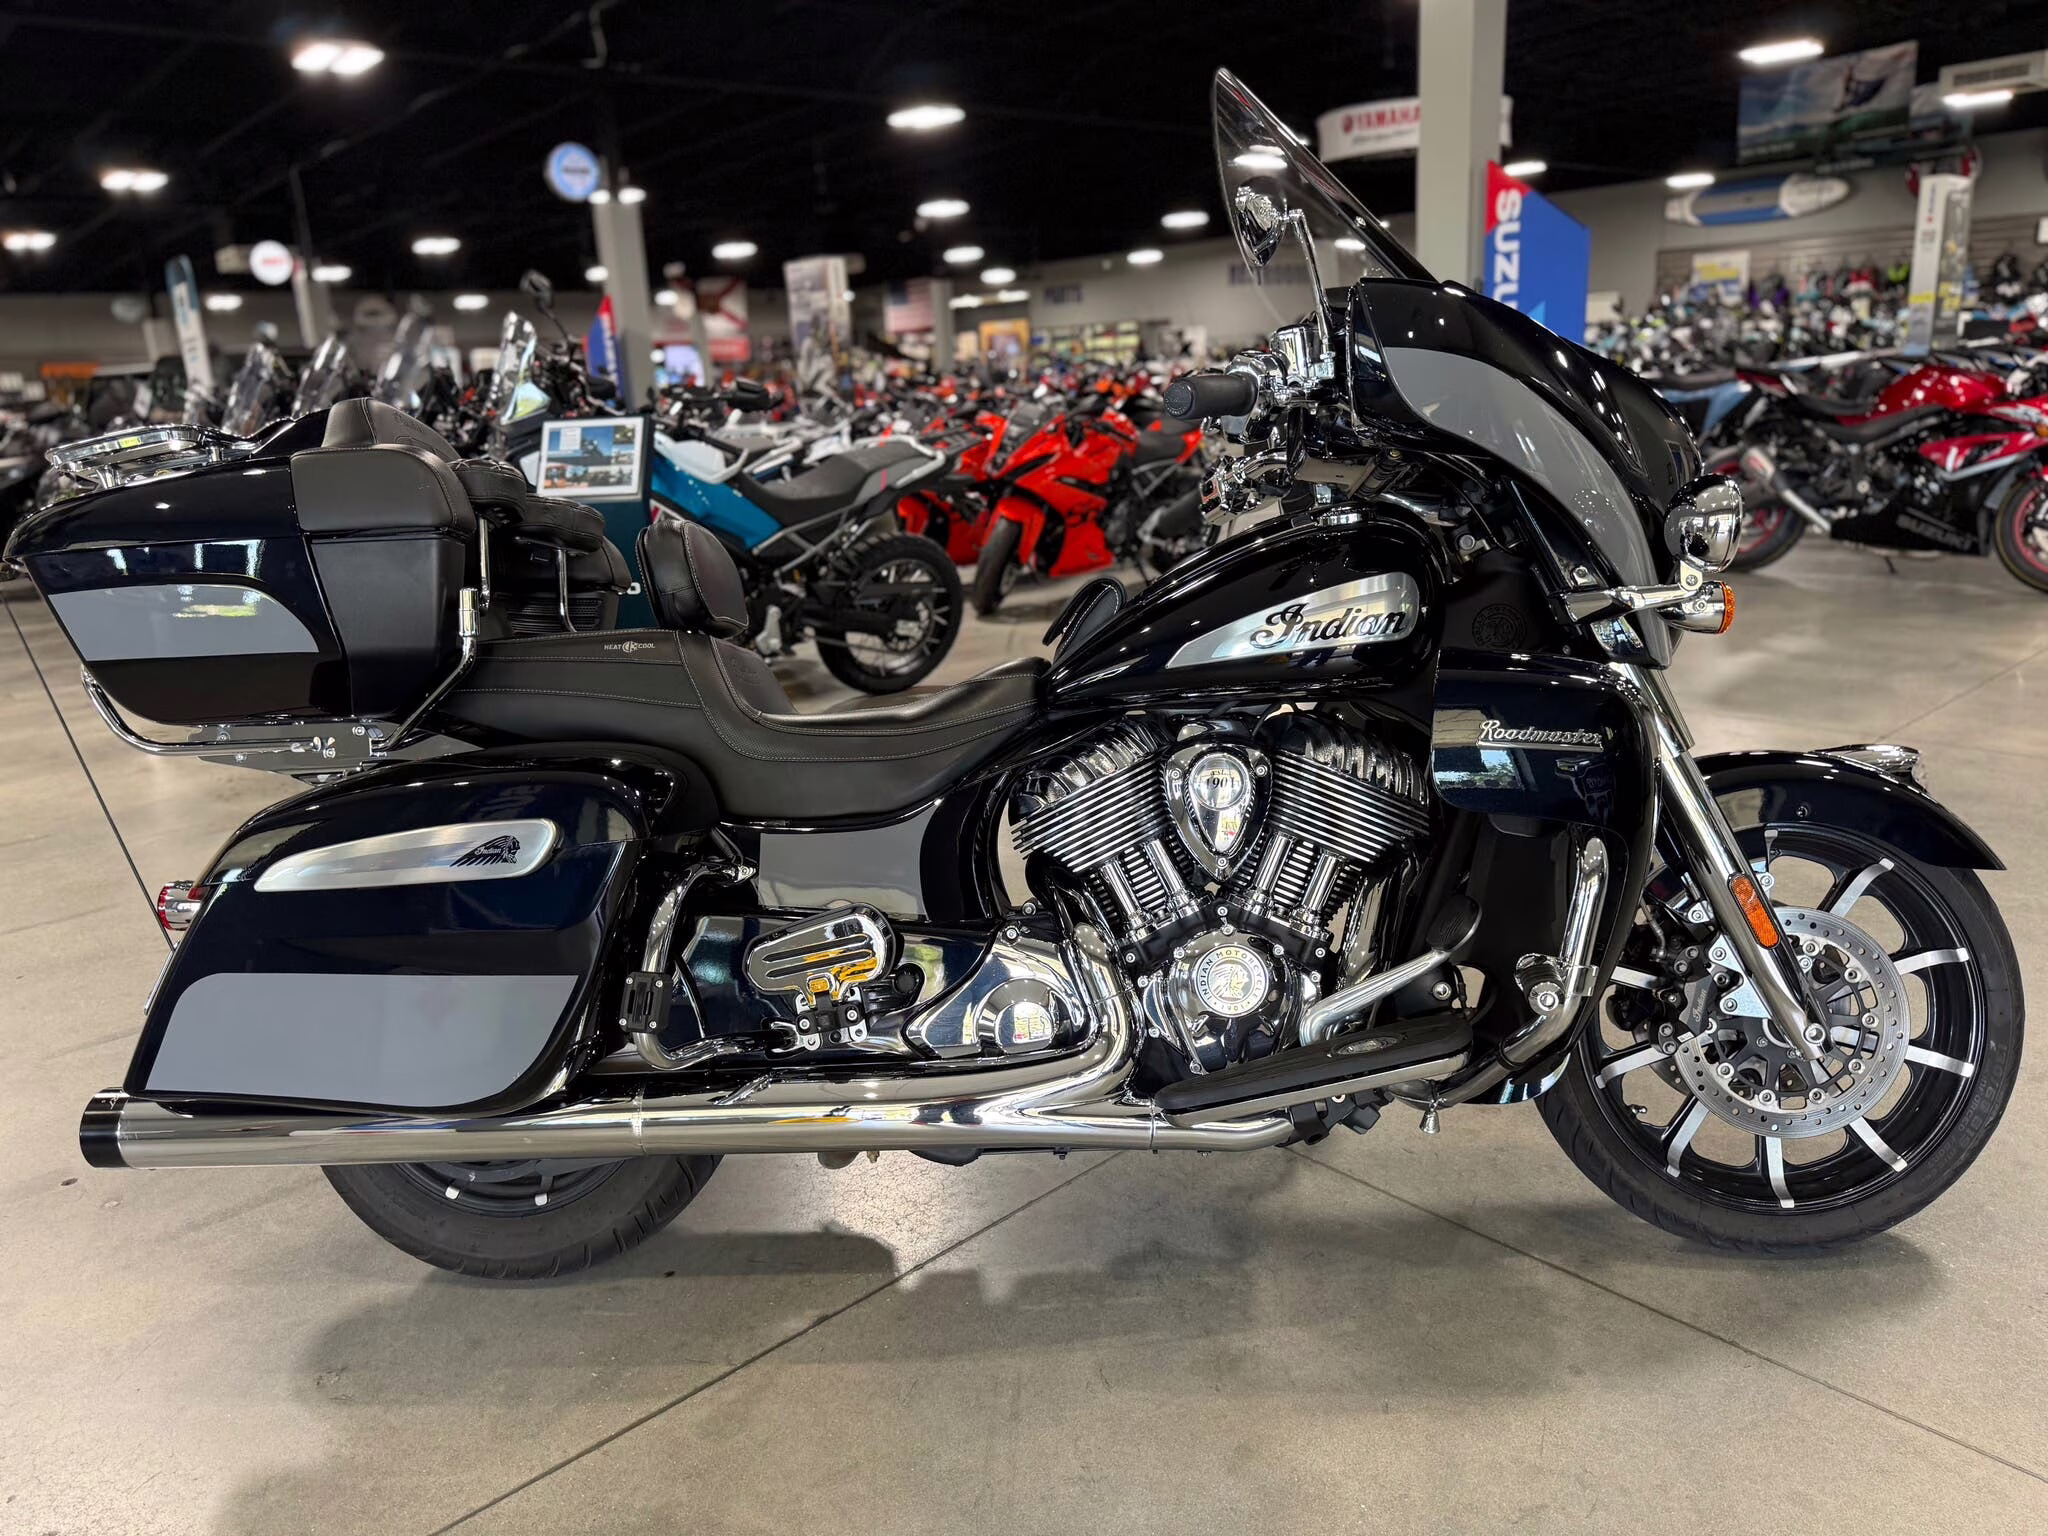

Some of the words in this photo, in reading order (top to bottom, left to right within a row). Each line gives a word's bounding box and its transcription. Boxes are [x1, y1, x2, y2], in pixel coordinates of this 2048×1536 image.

[1249, 602, 1408, 649] Indian
[1480, 720, 1602, 745] Roadmaster
[474, 846, 502, 855] Indian
[1200, 959, 1214, 1000] INDIAN
[1216, 949, 1263, 998] MOTORCYCLE
